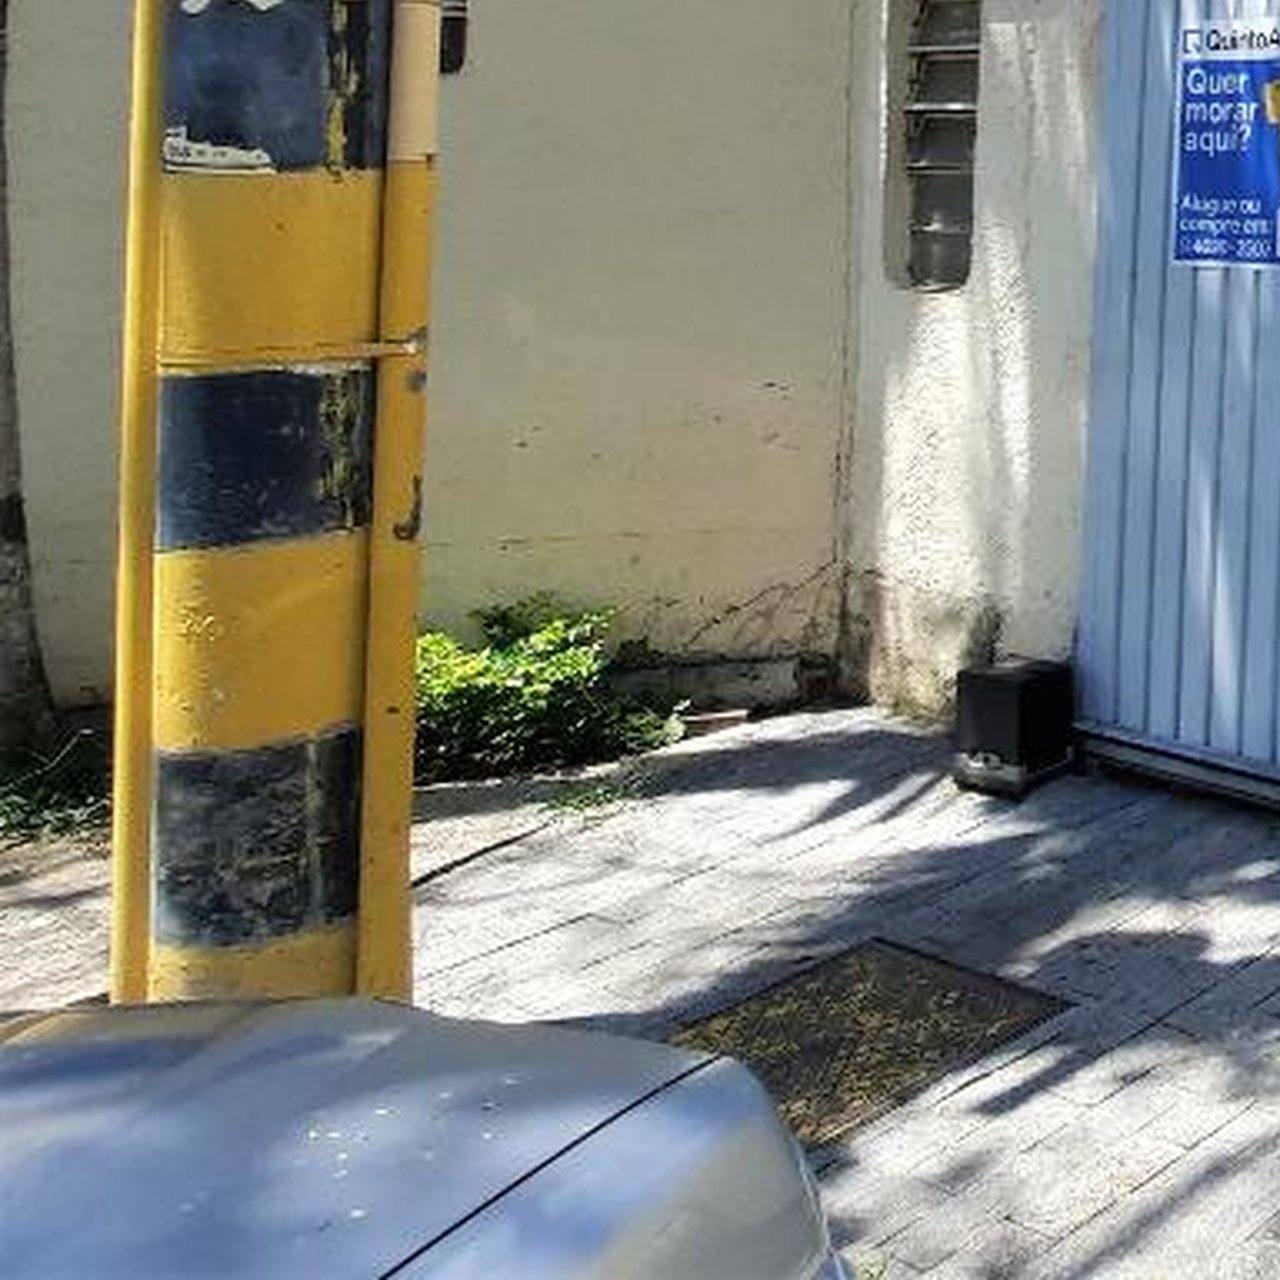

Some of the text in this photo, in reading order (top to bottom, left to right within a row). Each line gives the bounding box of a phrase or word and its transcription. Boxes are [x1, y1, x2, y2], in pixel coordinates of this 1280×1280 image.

[1186, 68, 1250, 95] Quer
[1185, 102, 1260, 124] morar
[1183, 123, 1252, 156] aqui?
